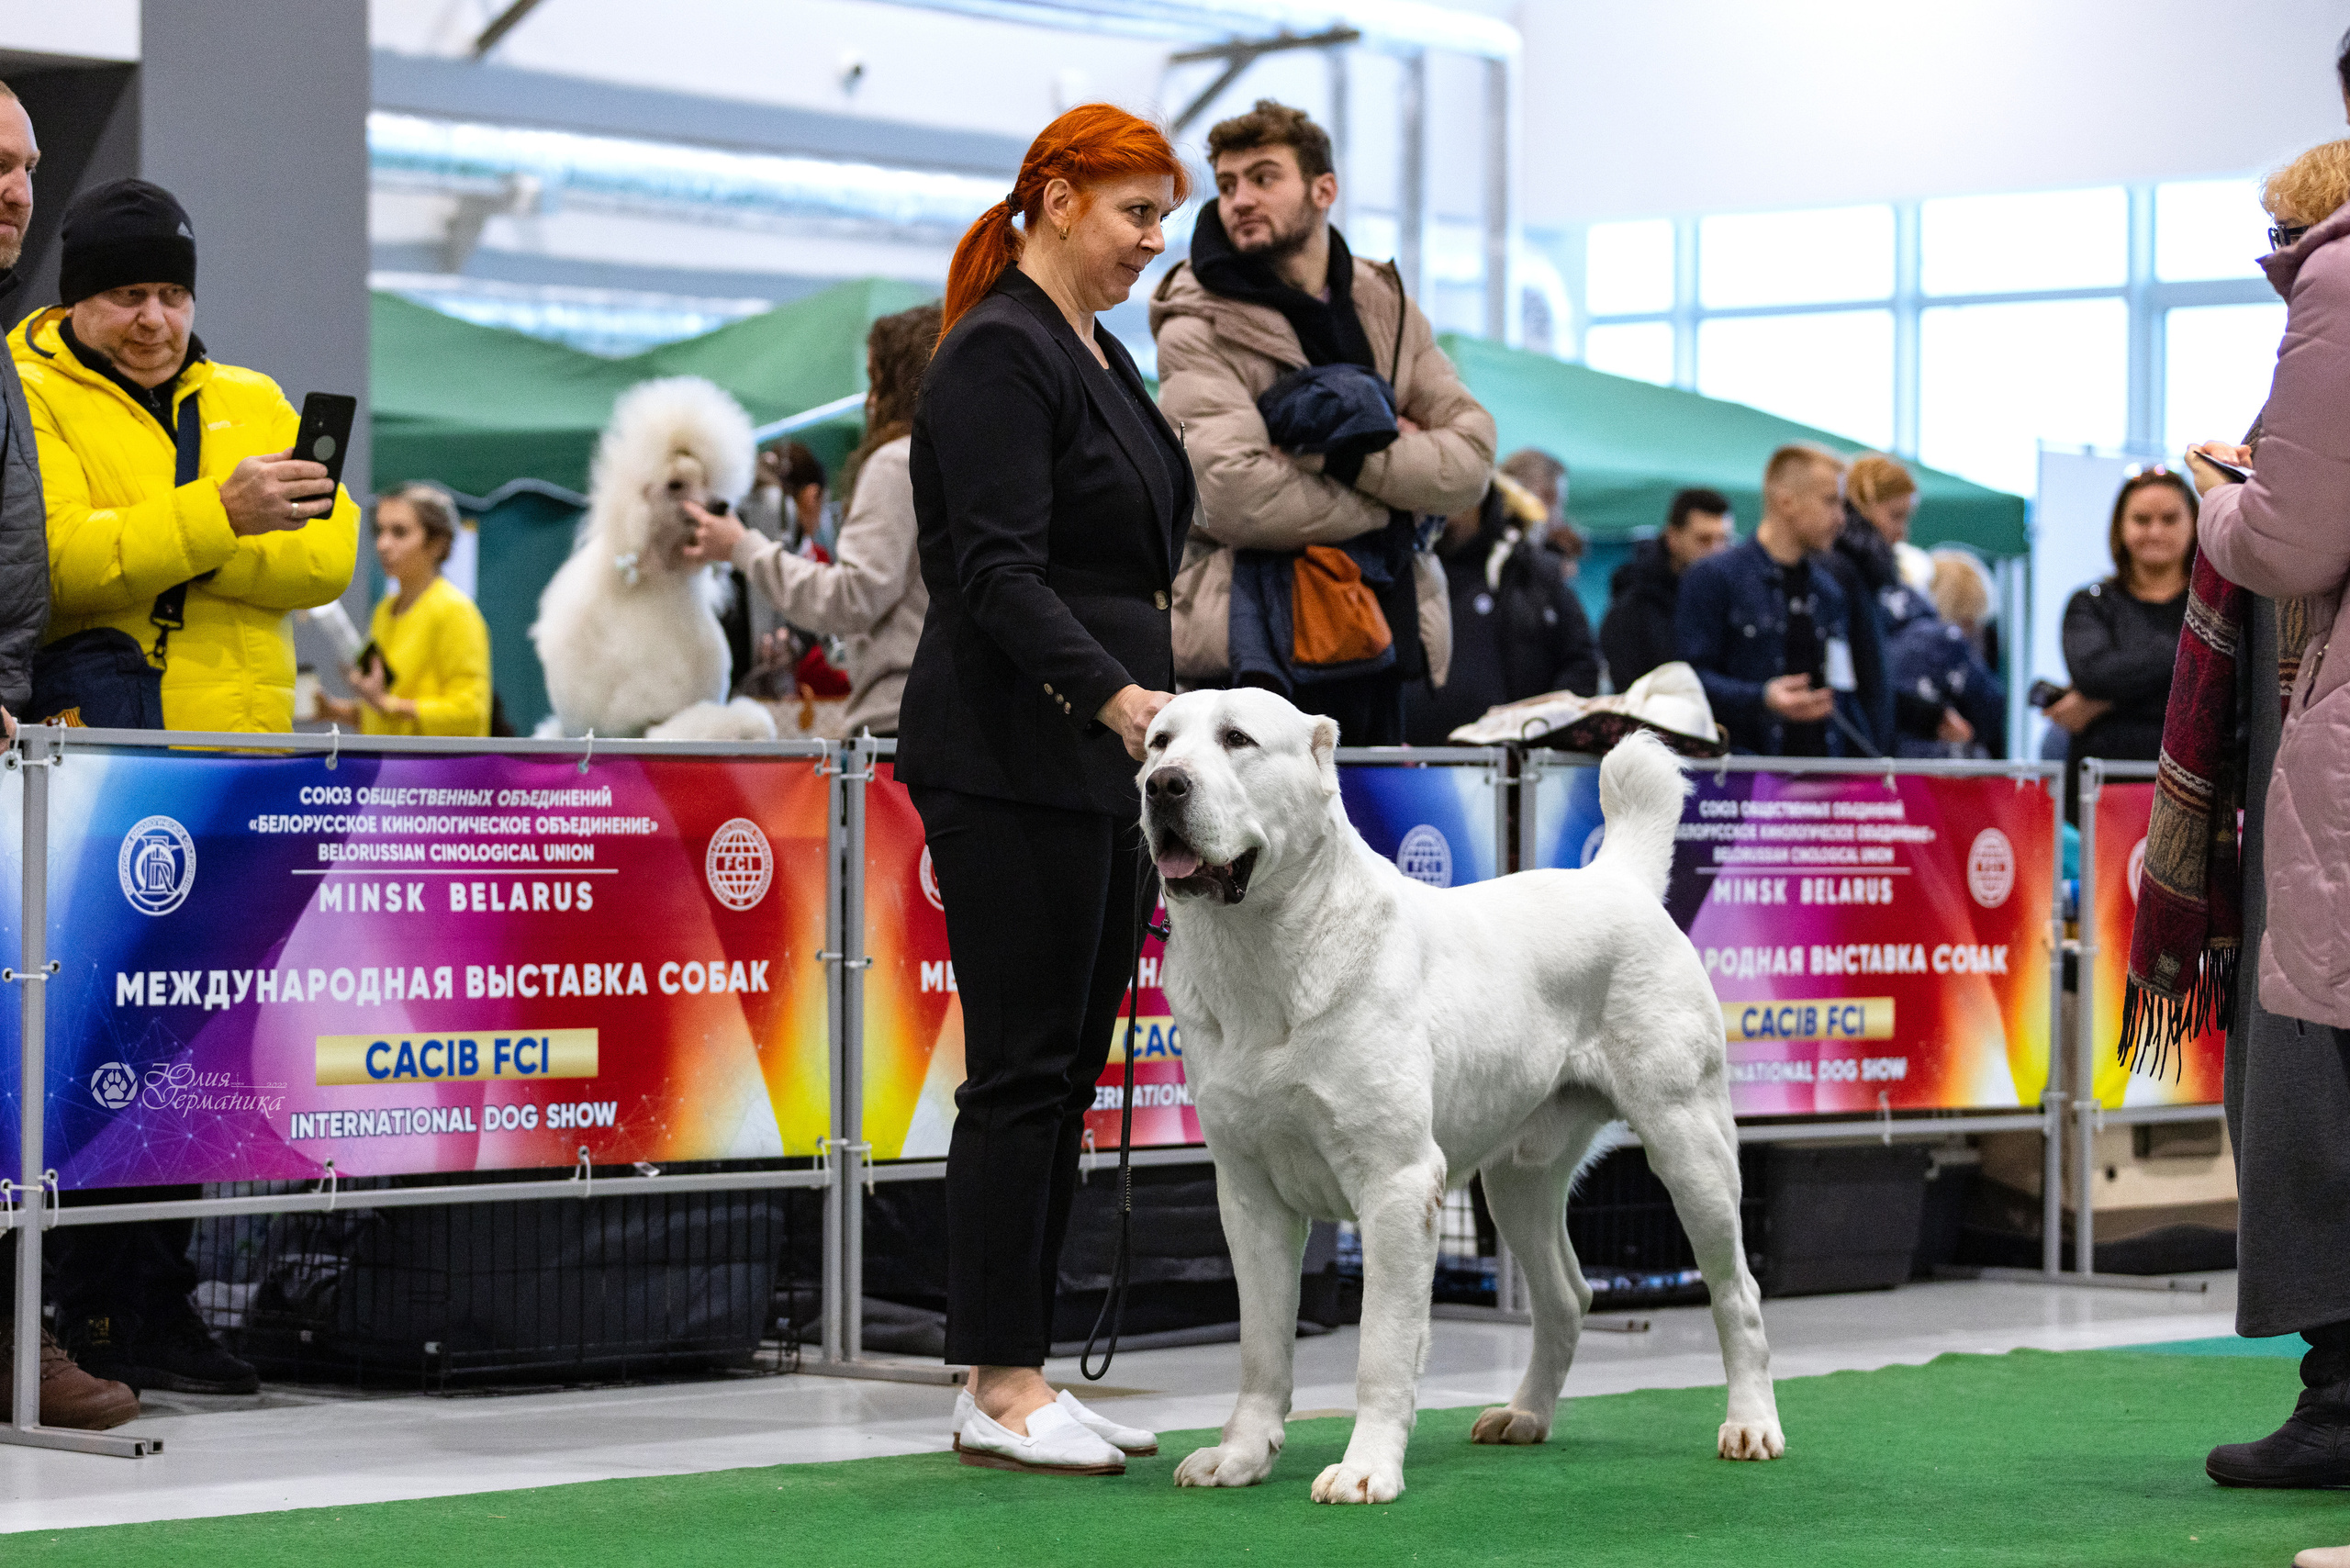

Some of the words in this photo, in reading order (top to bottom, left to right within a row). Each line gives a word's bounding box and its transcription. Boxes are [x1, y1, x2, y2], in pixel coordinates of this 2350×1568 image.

[300, 787, 352, 805] СОЮЗ
[356, 787, 492, 810] ОБЩЕСТВЕННЫХ
[497, 786, 613, 809] ОБЪЕДИНЕНИЙ
[249, 813, 377, 834] «БЕЛОРУССКОЕ
[382, 814, 532, 835] КИНОЛОГИЧЕСКОЕ
[535, 816, 659, 837] ОБЪЕДИНЕНИЕ»
[318, 843, 426, 862] BELORUSSIAN
[430, 843, 540, 863] CINOLOGICAL
[543, 843, 595, 862] UNION
[723, 856, 753, 871] FCI
[319, 882, 426, 913] MINSK
[449, 881, 594, 912] BELARUS
[1713, 878, 1787, 905] MINSK
[1800, 878, 1894, 905] BELARUS
[1809, 944, 1928, 975] ВЫСТАВКА
[116, 966, 453, 1012] МЕЖДУНАРОДНАЯ
[465, 962, 648, 1000] ВЫСТАВКА
[658, 959, 770, 996] СОБАК
[1741, 1007, 1818, 1038] CACIB
[1827, 1005, 1865, 1036] FCI
[365, 1039, 479, 1081] CACIB
[493, 1036, 549, 1076] FCI
[1818, 1058, 1858, 1081] DOG
[290, 1106, 476, 1139] INTERNATIONAL
[484, 1103, 538, 1132] DOG
[545, 1101, 618, 1130] SHOW
